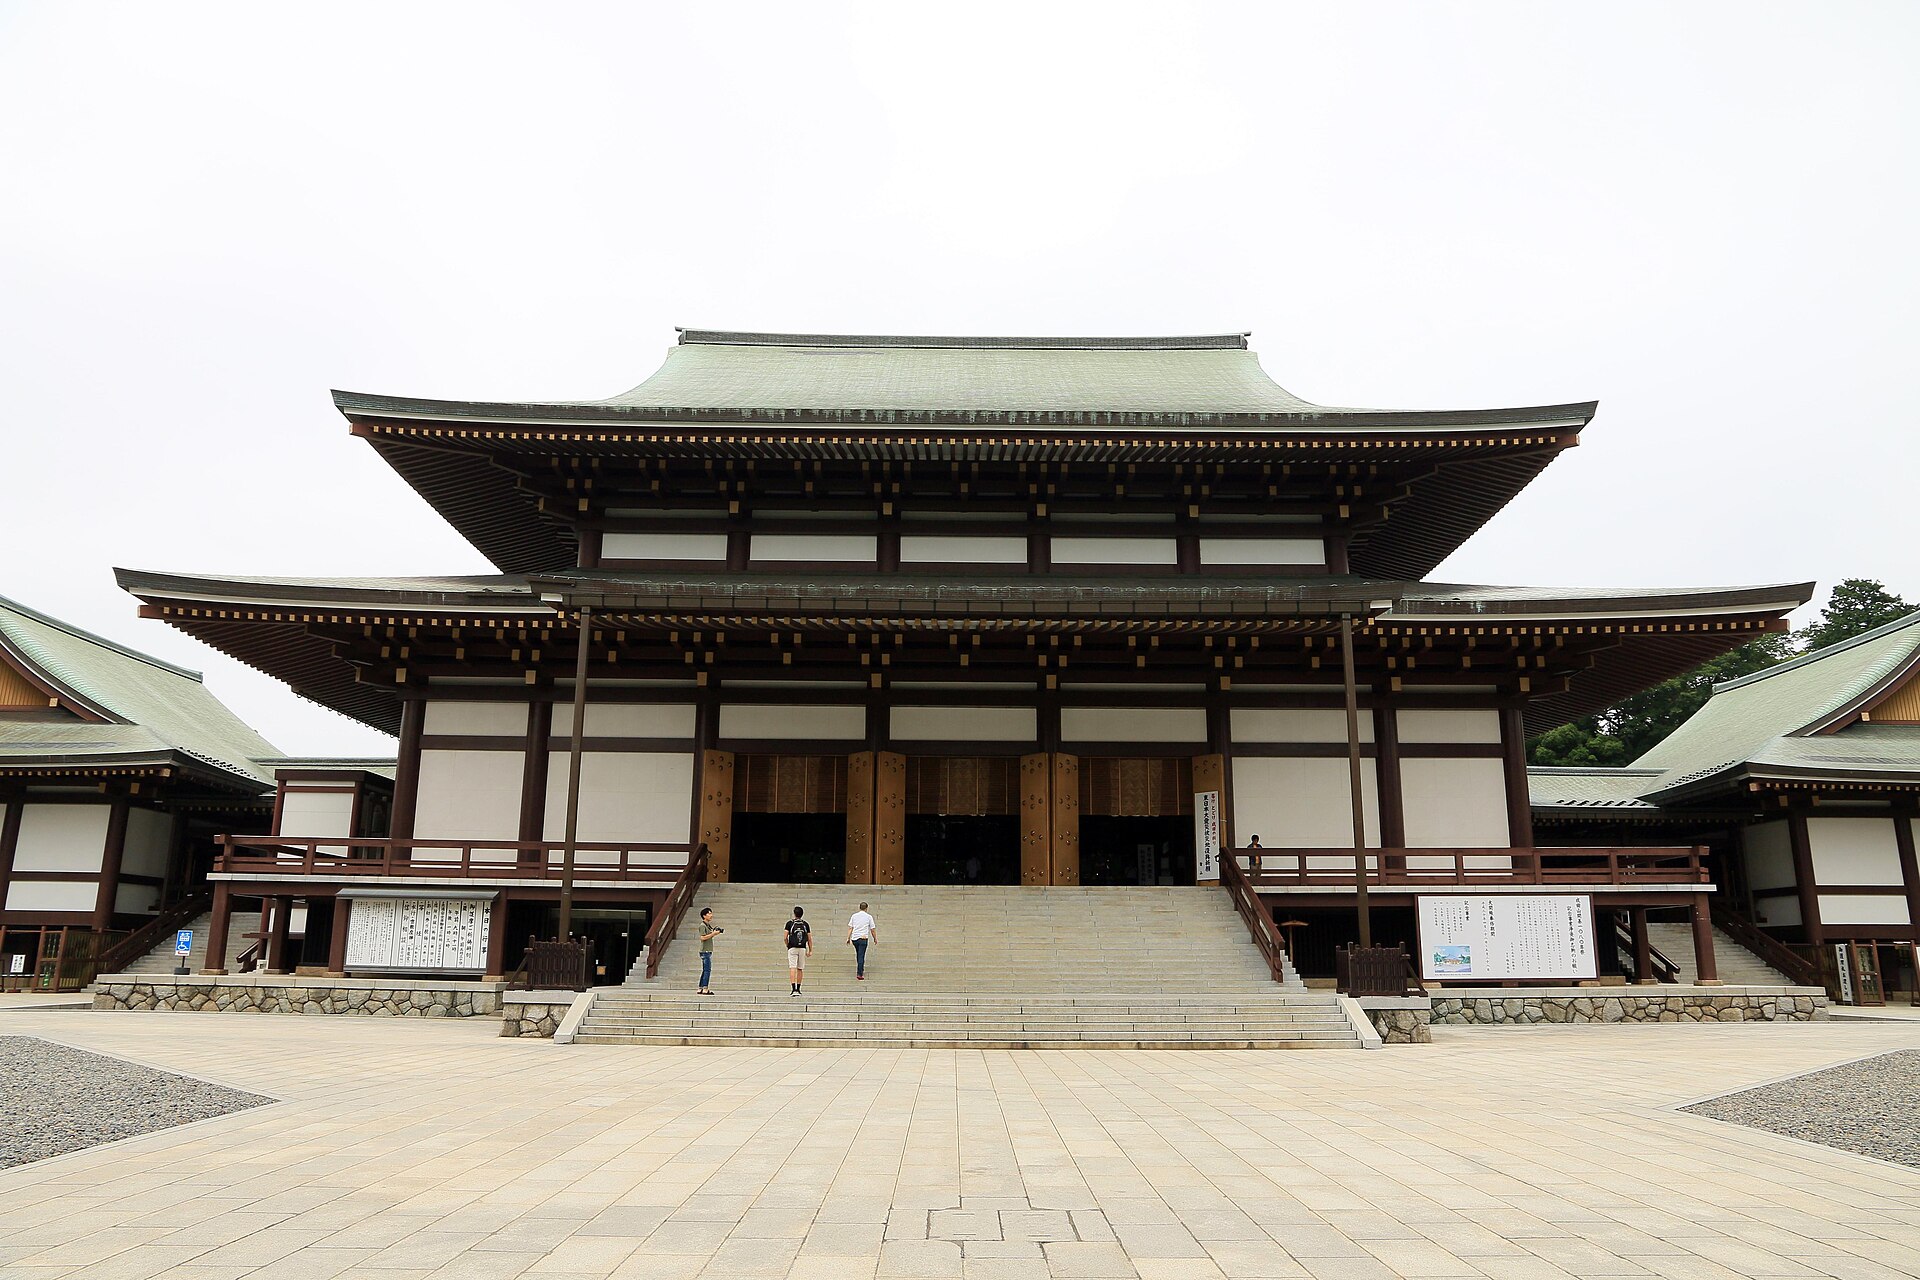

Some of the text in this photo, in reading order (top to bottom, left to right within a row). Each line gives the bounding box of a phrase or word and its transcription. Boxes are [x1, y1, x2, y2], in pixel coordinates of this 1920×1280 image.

[482, 907, 491, 954] 本日の行事
